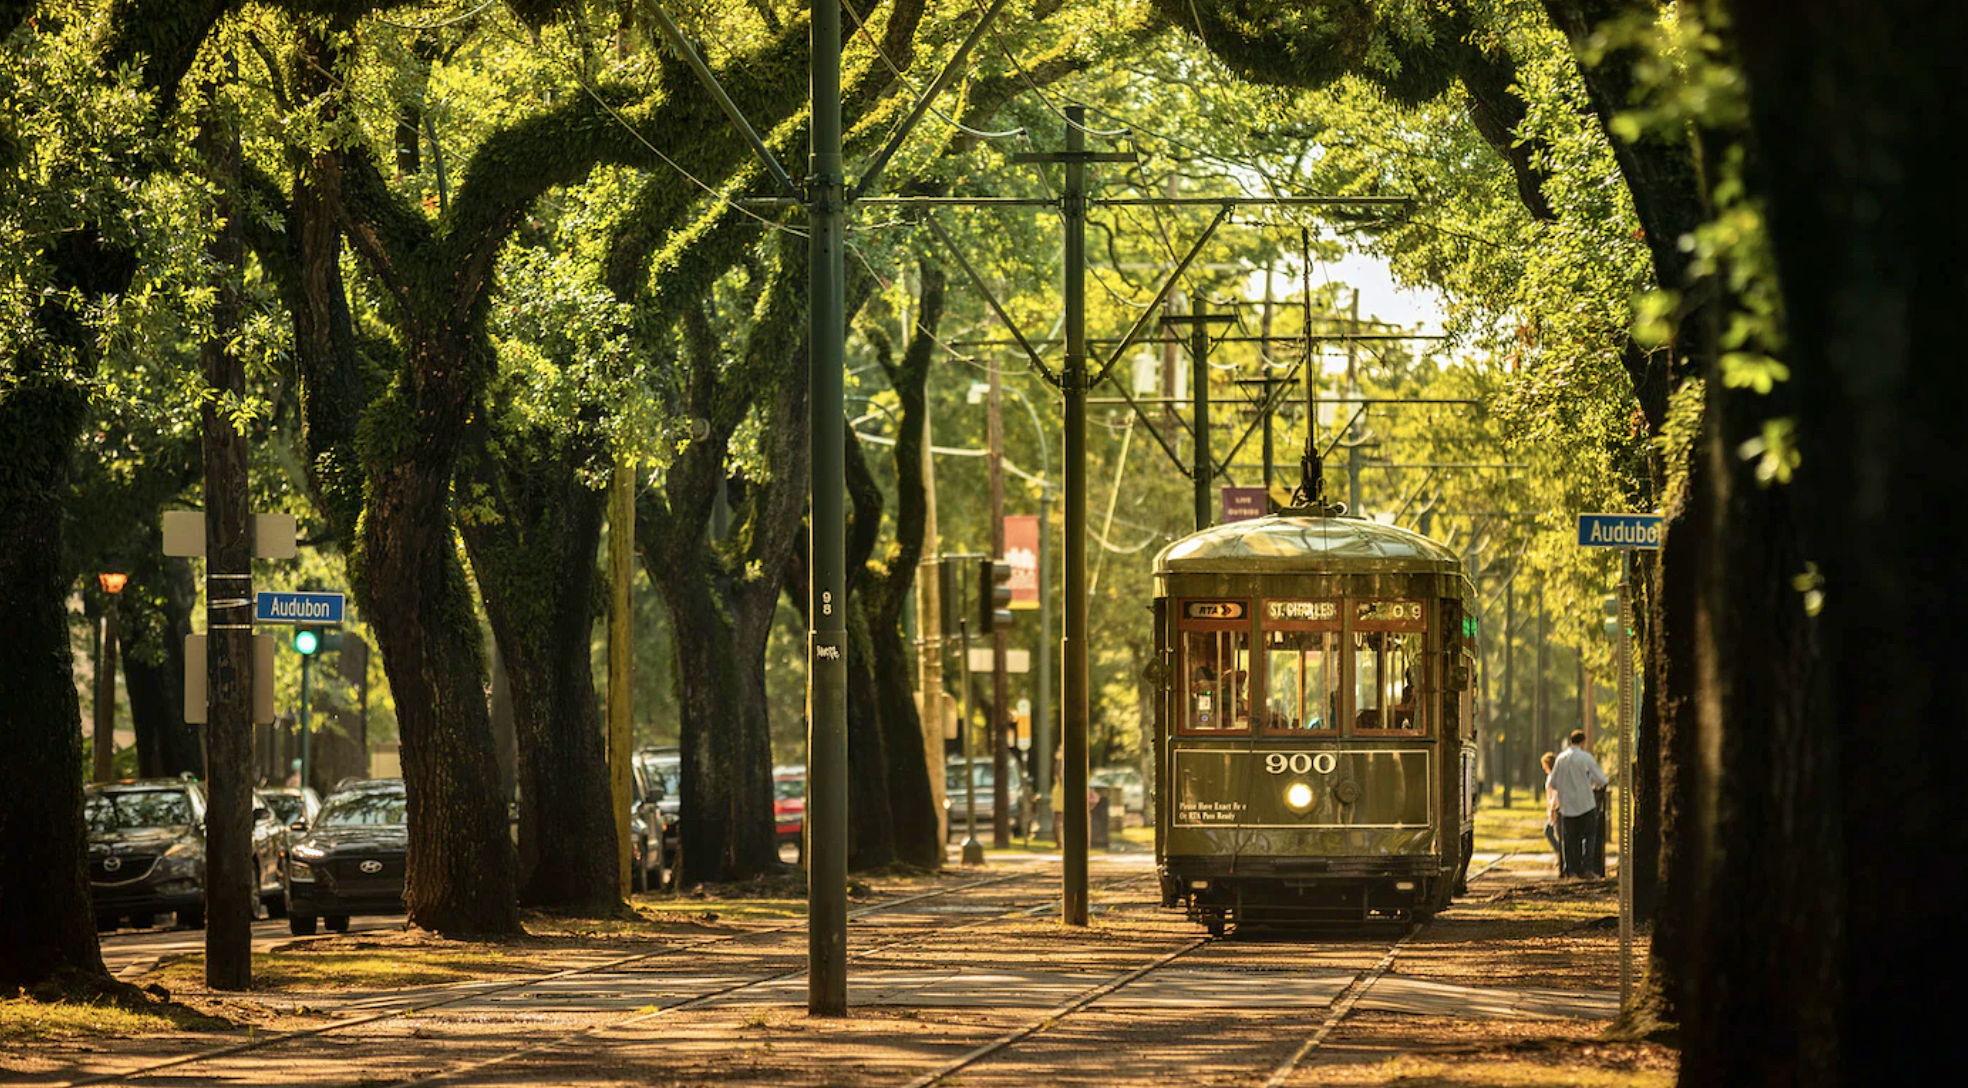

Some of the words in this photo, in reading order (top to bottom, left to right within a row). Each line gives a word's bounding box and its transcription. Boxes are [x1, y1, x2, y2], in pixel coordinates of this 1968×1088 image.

[1590, 519, 1660, 543] Audubo
[270, 596, 330, 618] Audubon
[1199, 606, 1218, 615] RTA
[1265, 754, 1337, 774] 900
